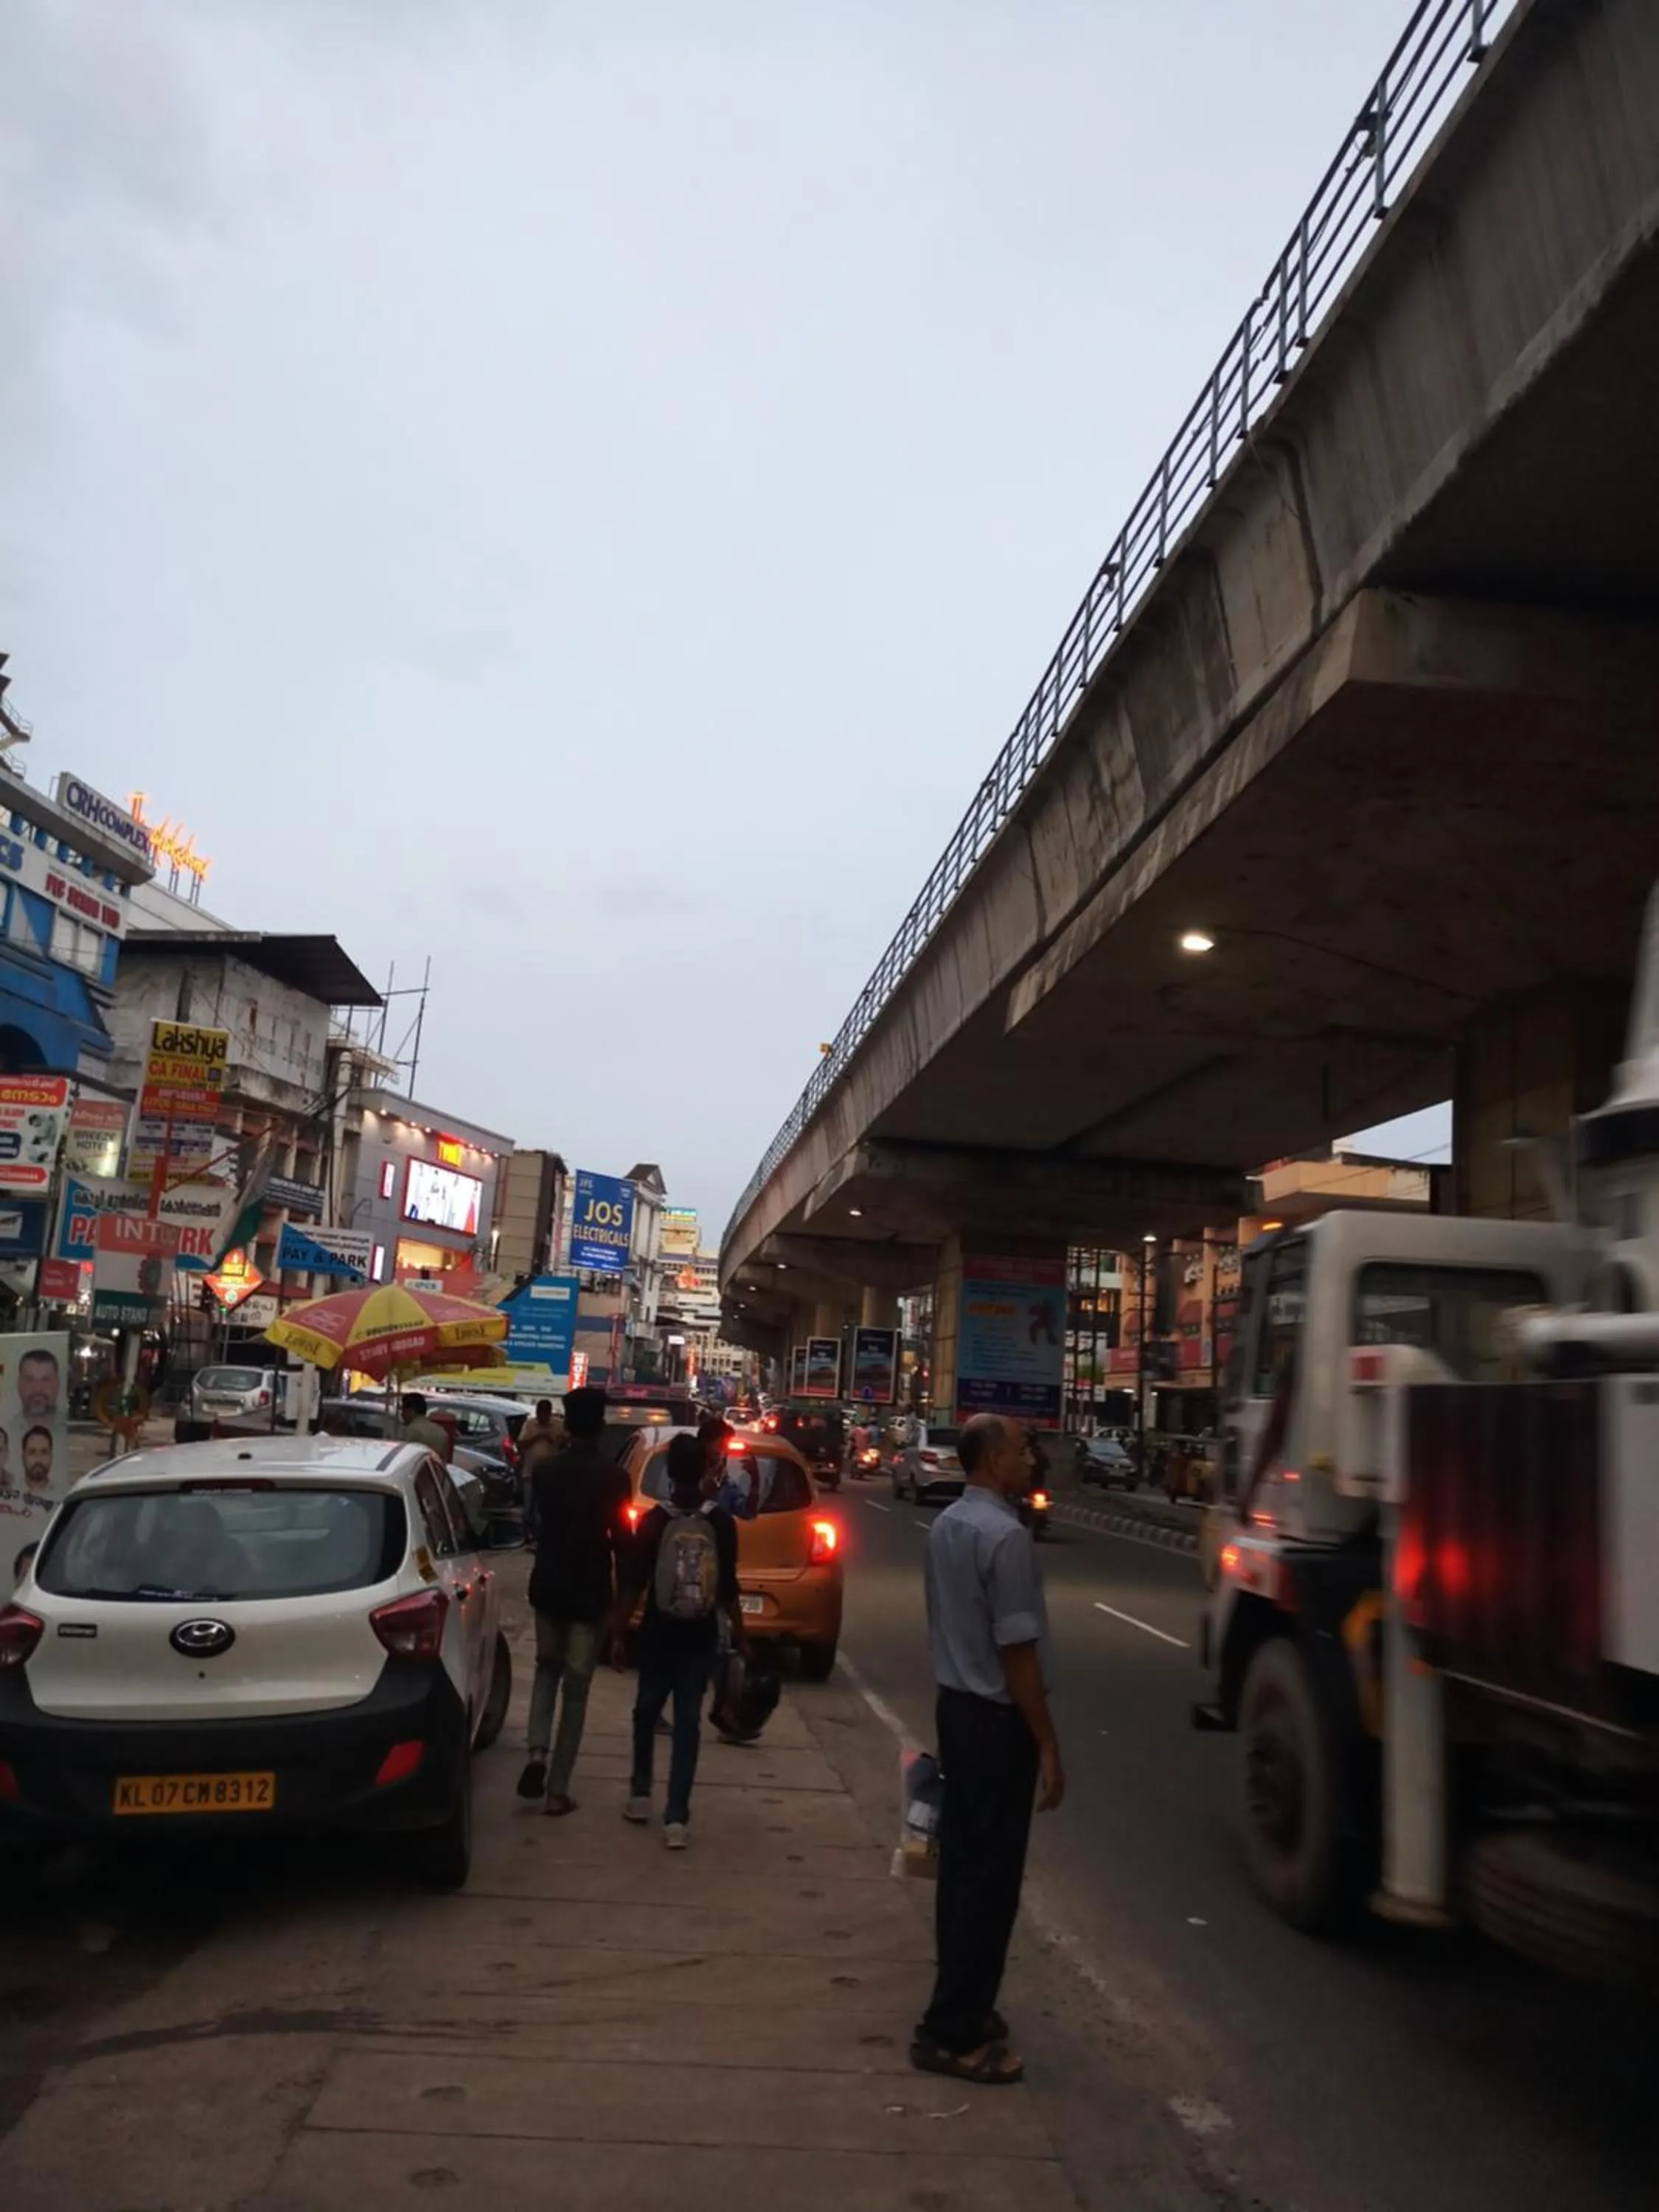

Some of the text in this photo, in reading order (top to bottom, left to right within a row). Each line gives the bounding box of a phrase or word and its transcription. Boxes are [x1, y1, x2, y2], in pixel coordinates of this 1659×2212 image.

[152, 1022, 227, 1064] Lakshya
[583, 1198, 624, 1228] JOS
[70, 1216, 94, 1245] PA
[574, 1223, 629, 1248] ELECTRICALS
[282, 1246, 307, 1261] PAY
[330, 1252, 366, 1269] PARK
[95, 1304, 149, 1322] AUTO STAND
